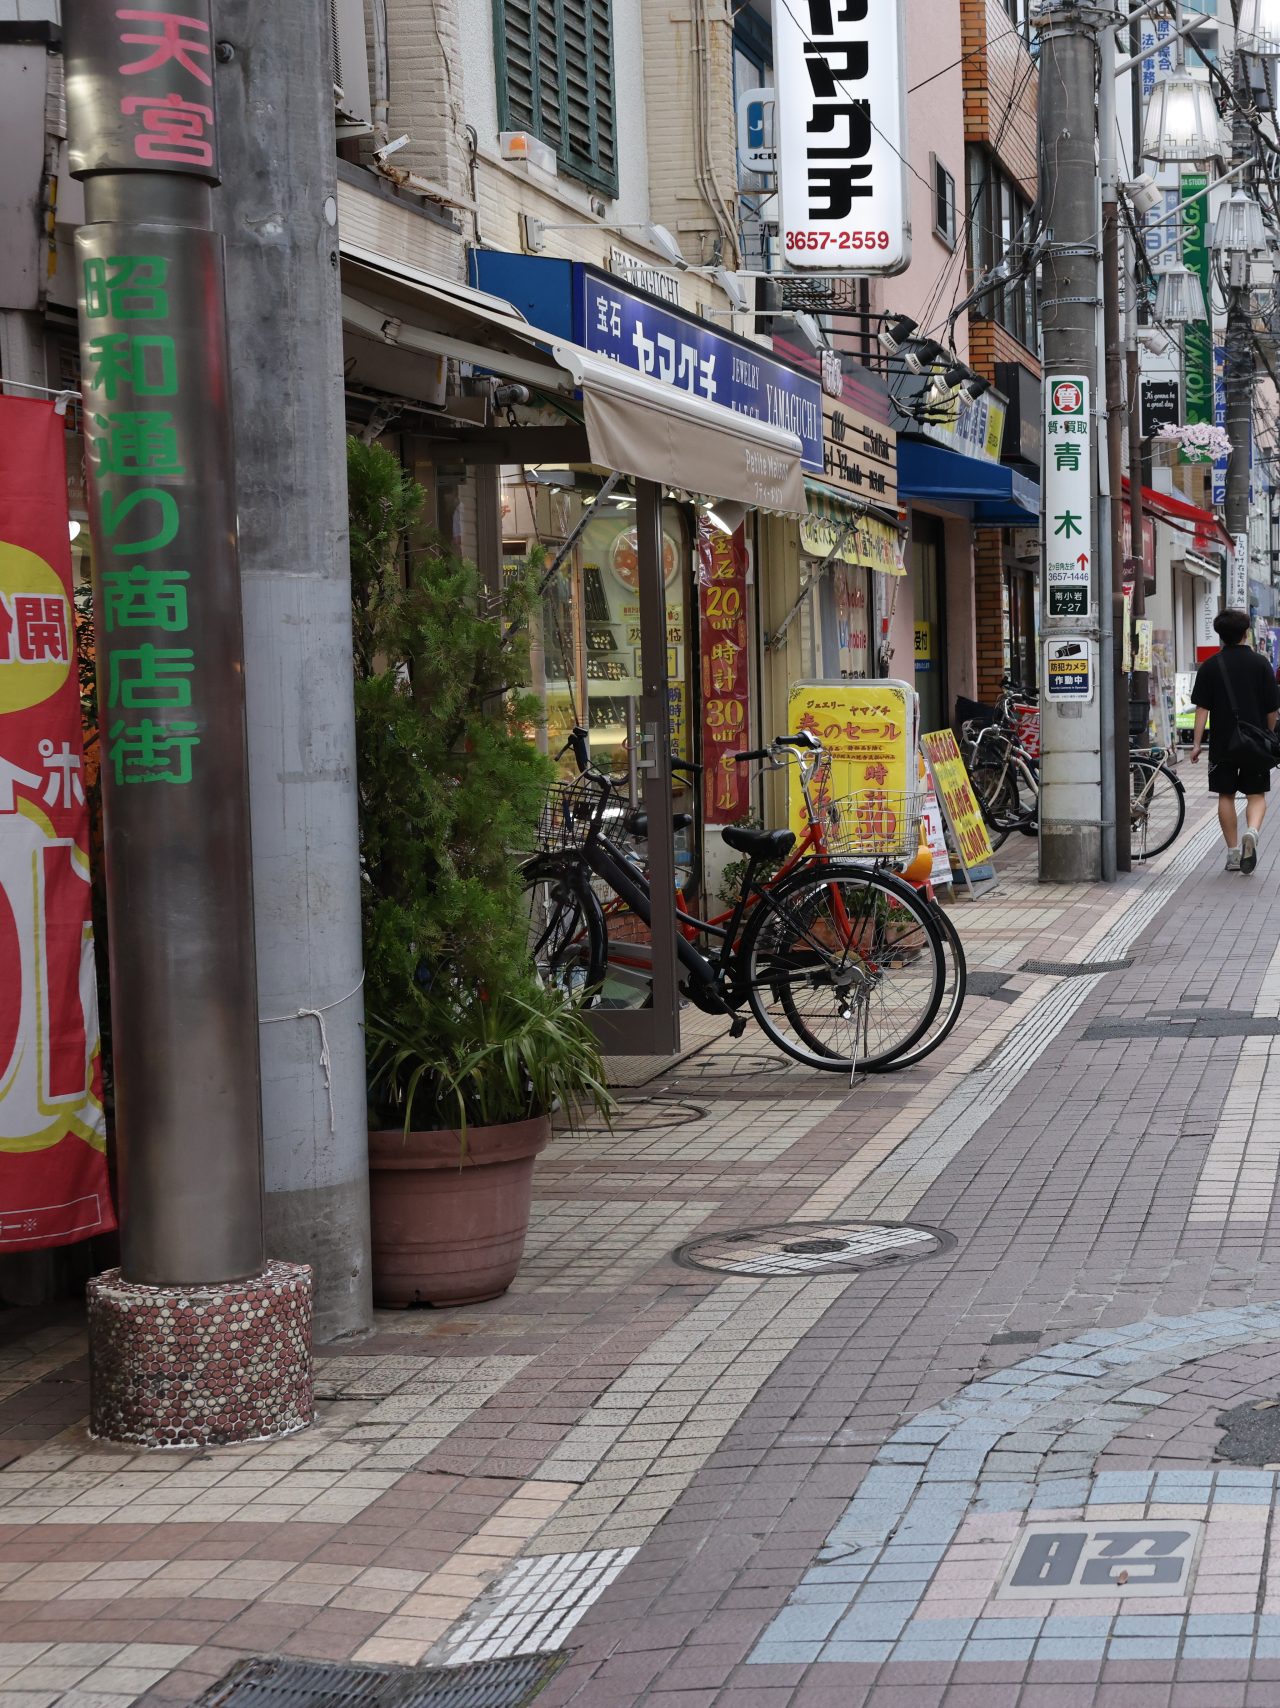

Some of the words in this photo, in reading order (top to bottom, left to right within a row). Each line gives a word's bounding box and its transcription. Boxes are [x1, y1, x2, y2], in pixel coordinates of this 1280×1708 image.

[115, 8, 213, 167] 天宮
[749, 152, 777, 160] JCB
[785, 231, 889, 250] 3657-2559
[596, 295, 621, 338] 宝石
[632, 320, 717, 402] ヤマグチ
[731, 357, 760, 389] JEWELRY
[1056, 387, 1079, 409] 質
[766, 384, 818, 442] YAMAGUCHI
[1048, 420, 1088, 435] 質・買取
[745, 449, 767, 475] Petite
[1054, 441, 1082, 539] 青木
[84, 256, 200, 785] 昭和通り商店街
[709, 529, 737, 580] 宝石
[1048, 572, 1089, 581] 3657-1446
[1055, 591, 1083, 601] 南小岩
[1056, 603, 1081, 612] 7-27
[712, 618, 735, 630] off
[1204, 597, 1212, 641] SoftBank
[711, 639, 737, 691] 時計
[1050, 662, 1087, 672] 防犯カメラ
[1054, 675, 1083, 686] 作動中
[806, 700, 846, 710] ジュエリー
[849, 705, 891, 717] ヤマグチ
[712, 730, 736, 742] off
[795, 712, 902, 741] 春のセール
[716, 752, 737, 810] セール
[1010, 1530, 1191, 1587] 昭
